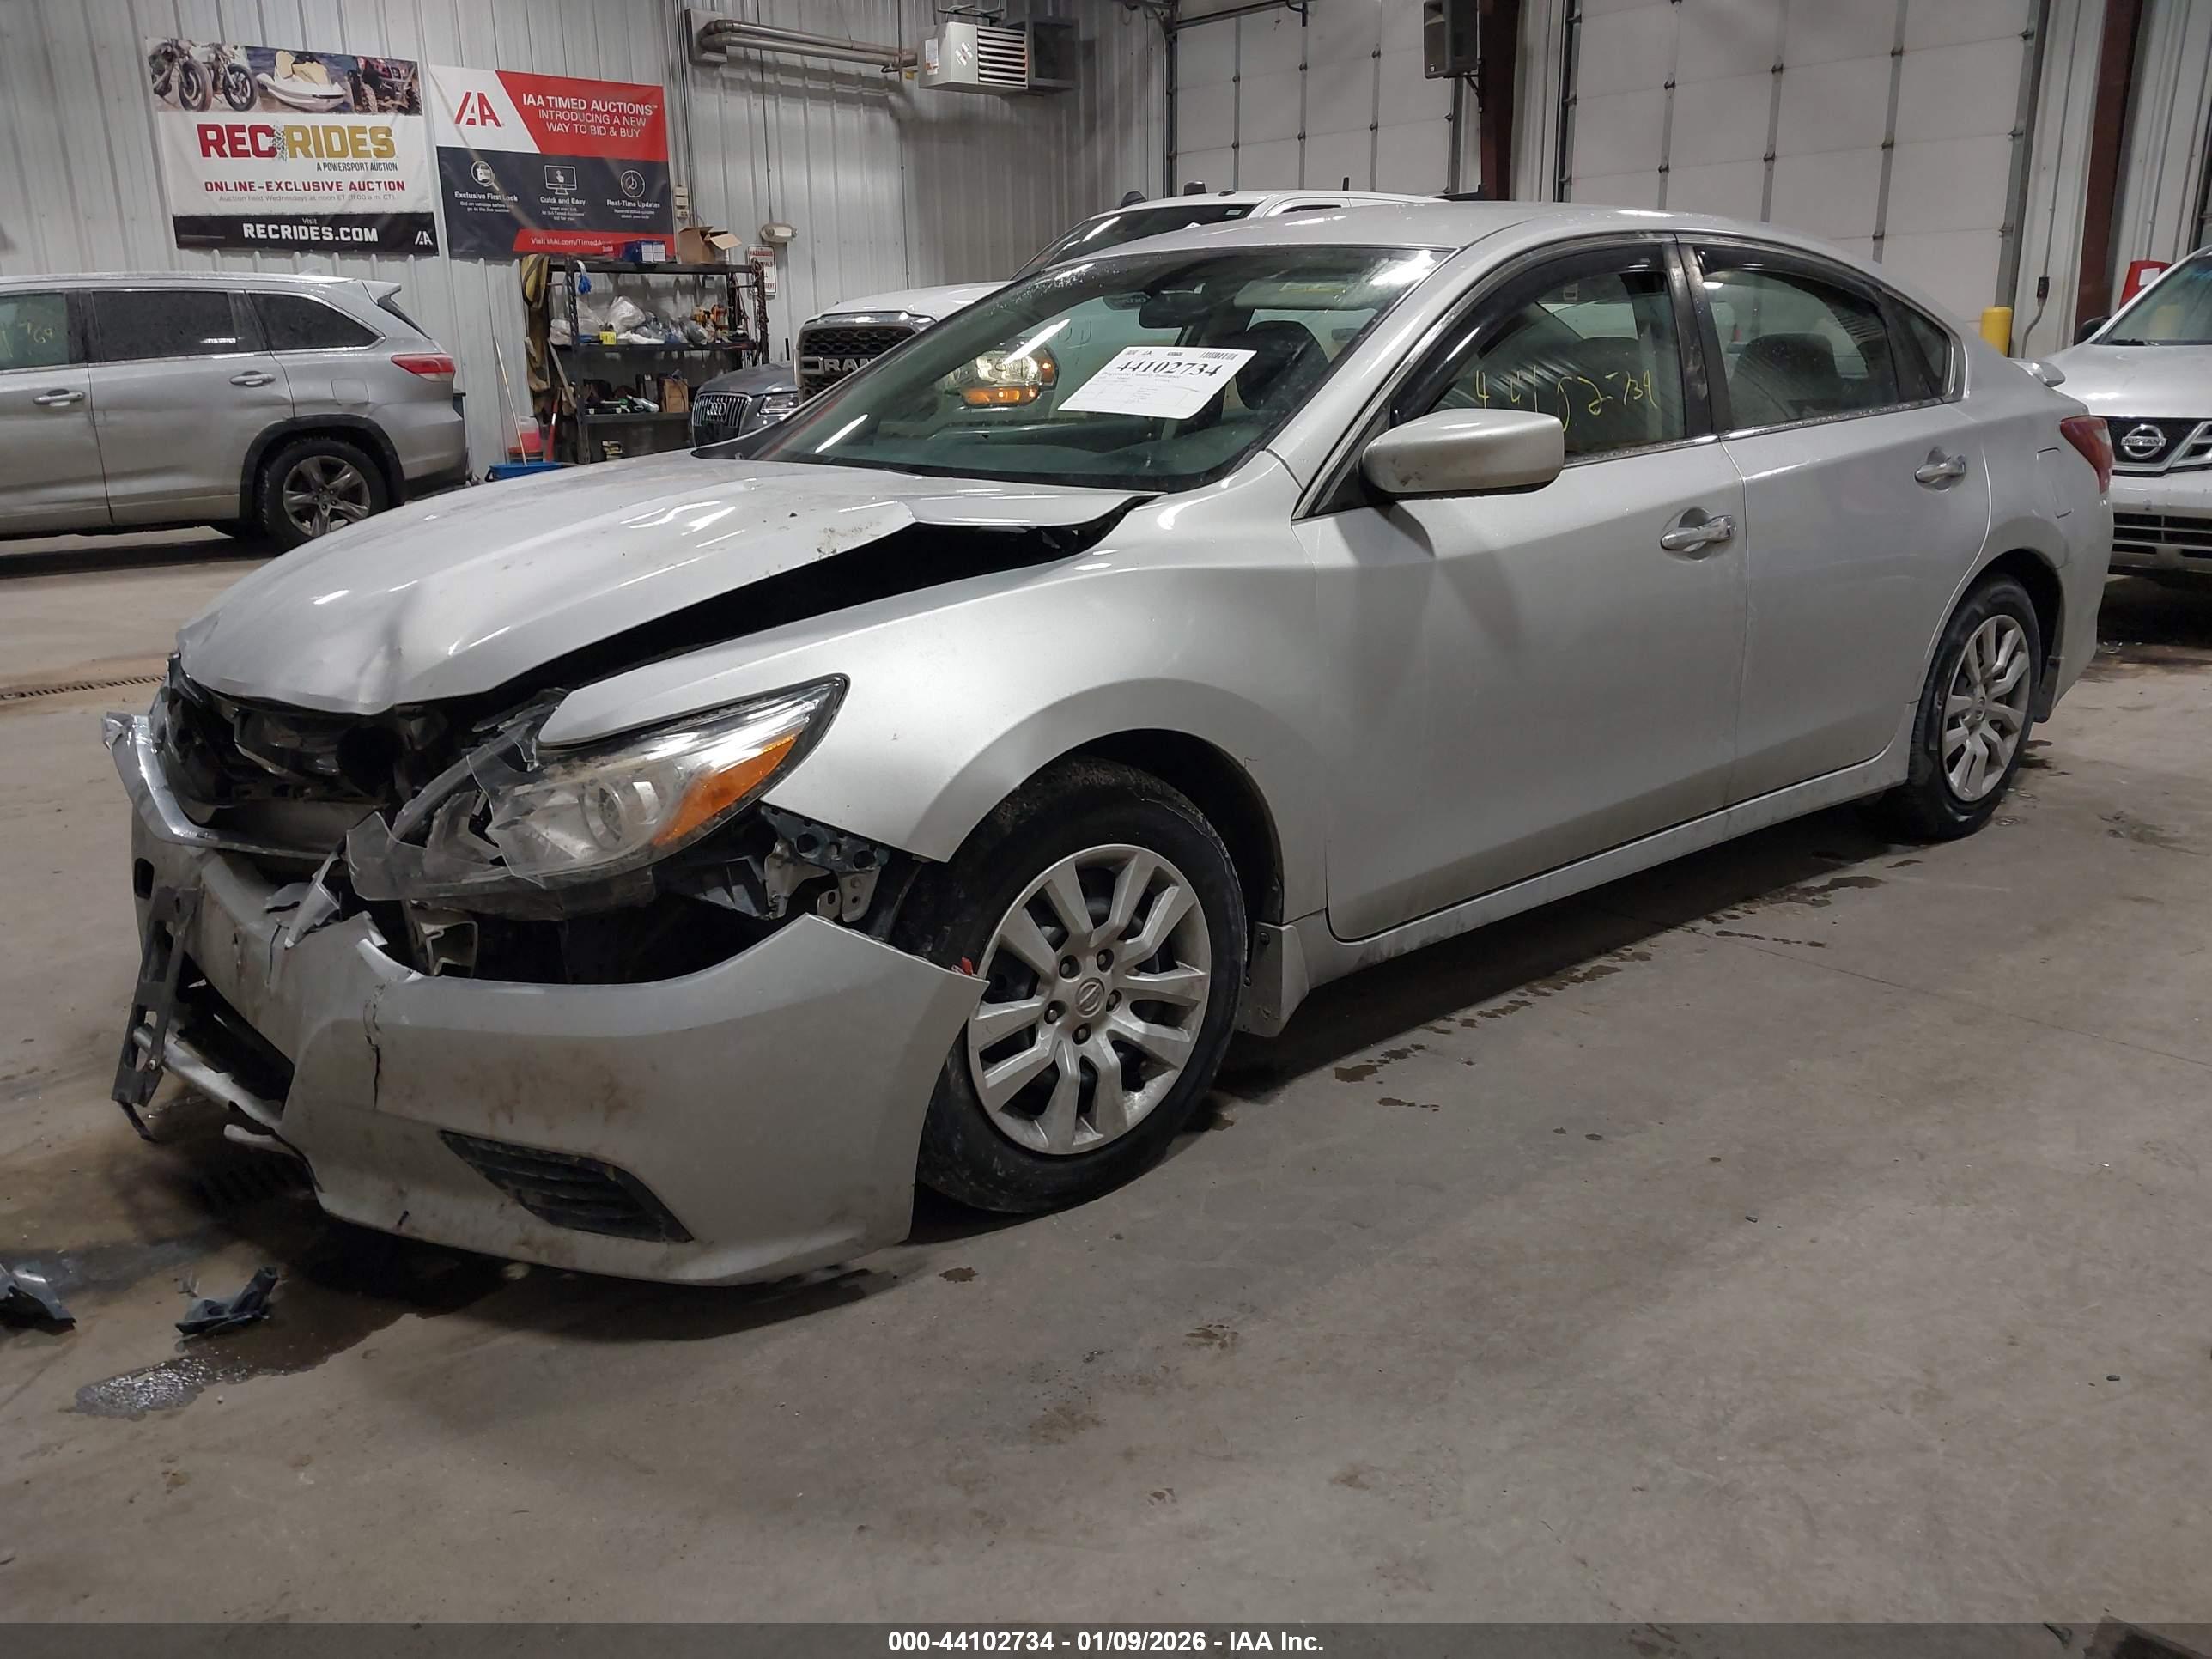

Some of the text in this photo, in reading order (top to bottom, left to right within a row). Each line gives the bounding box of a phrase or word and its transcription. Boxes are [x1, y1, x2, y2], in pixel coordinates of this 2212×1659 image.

[522, 93, 544, 106] IAA
[546, 95, 586, 111] TIMED
[539, 109, 647, 126] INTRODUCING A NEW
[546, 122, 641, 137] WAY TO BID & BUY
[316, 161, 398, 172] A POWERSPORT AUCTION
[204, 181, 405, 191] ONLINE-EXCLUSIVE AUCTION
[454, 191, 518, 202] Exclusive First Look
[540, 196, 556, 204] Quick
[242, 223, 379, 241] RECRIDES.COM
[1116, 360, 1223, 377] 44102734
